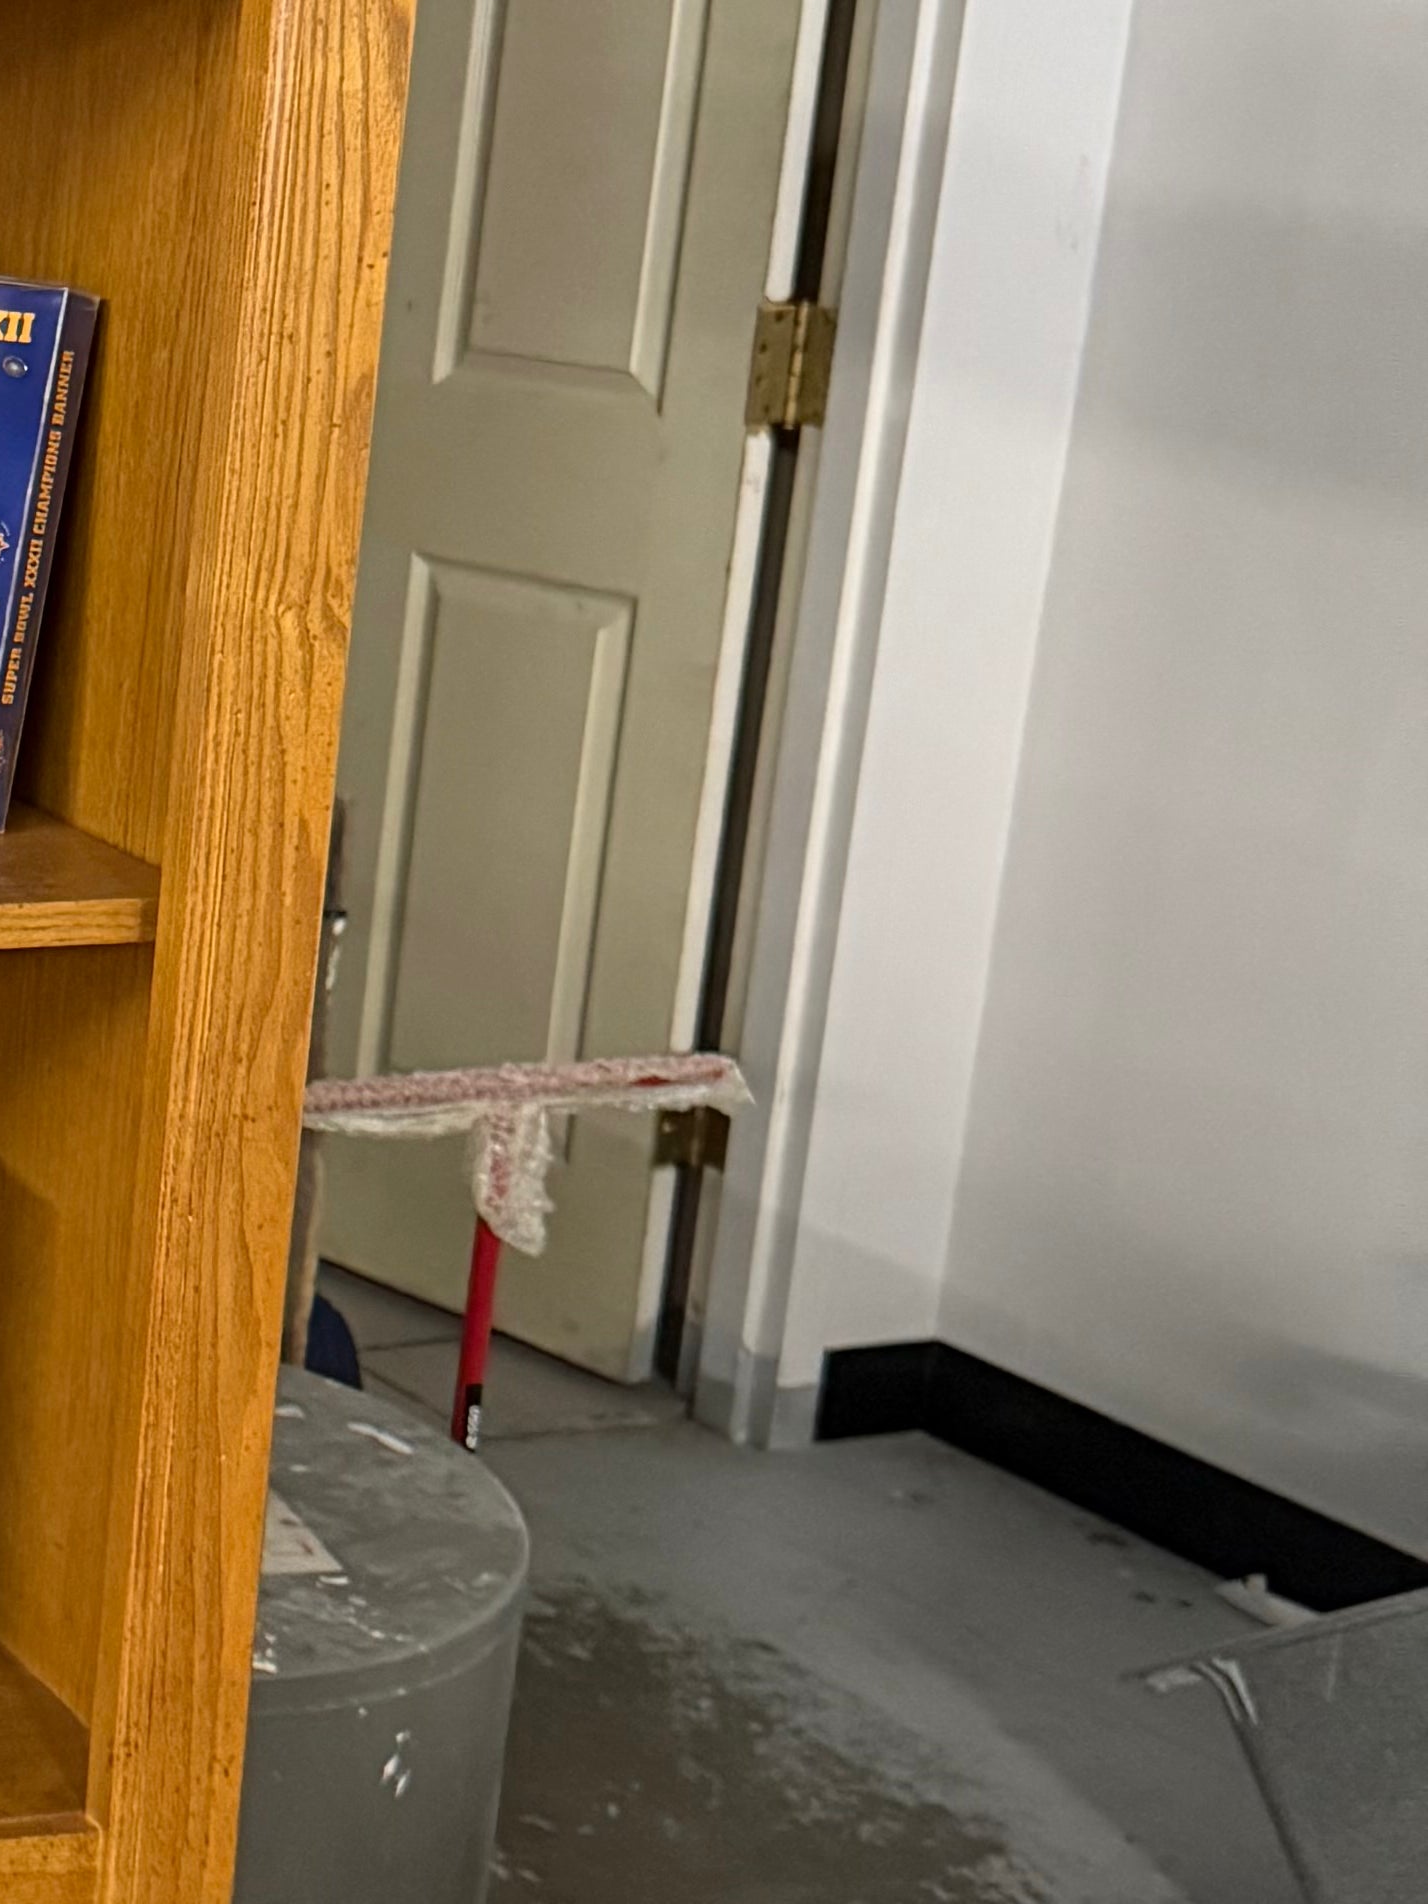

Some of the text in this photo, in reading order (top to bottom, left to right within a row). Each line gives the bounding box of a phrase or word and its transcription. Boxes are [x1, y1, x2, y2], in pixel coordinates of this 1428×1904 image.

[1, 648, 22, 705] SUPER
[13, 593, 34, 644] BOWL
[33, 430, 62, 535] CHAMPIONS
[51, 350, 75, 426] BANNER
